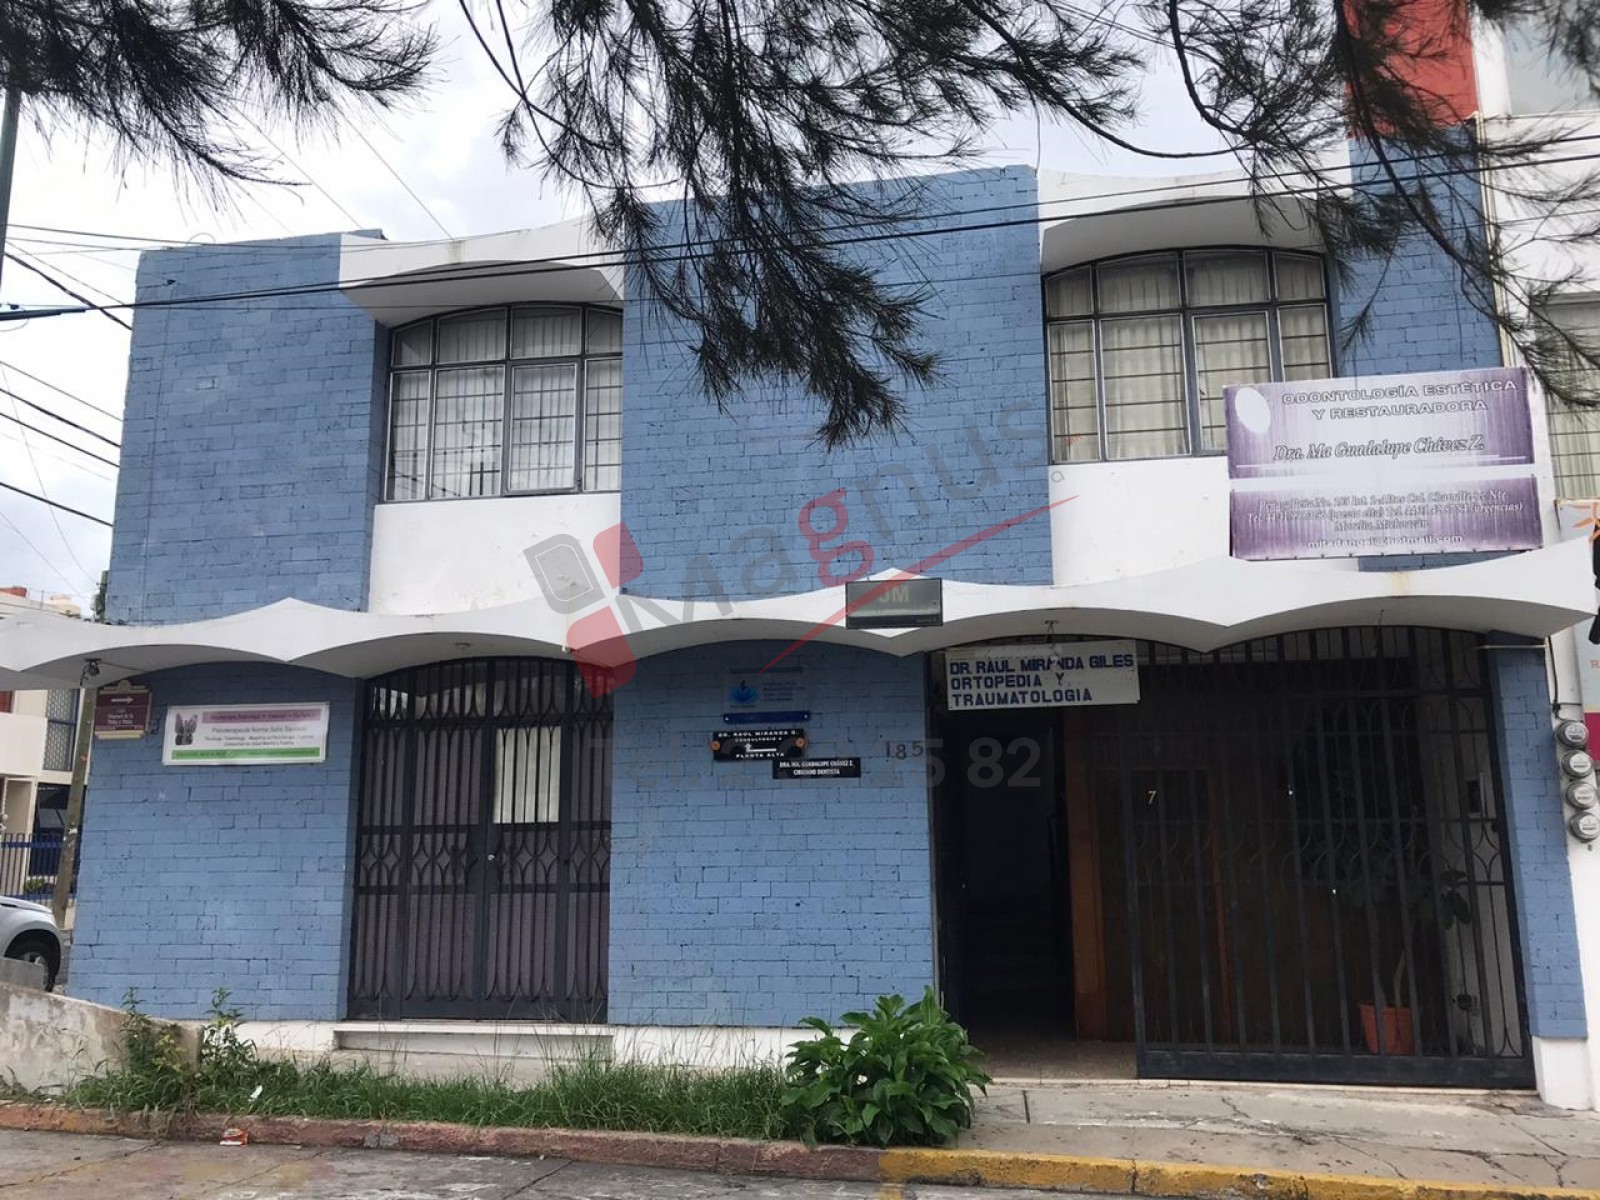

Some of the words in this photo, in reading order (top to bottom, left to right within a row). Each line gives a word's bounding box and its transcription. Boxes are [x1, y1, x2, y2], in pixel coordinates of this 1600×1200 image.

[1281, 384, 1419, 406] ODONTOLOGÍA
[1311, 408, 1326, 421] Y
[1329, 399, 1489, 420] RESTAURADORA
[1273, 445, 1305, 462] Dra.
[1334, 438, 1412, 459] Guadalupe
[949, 662, 972, 676] DR.
[975, 660, 1015, 674] RAUL
[1089, 654, 1133, 669] GILES
[951, 674, 1042, 690] ORTOPEDIA
[1056, 673, 1065, 686] Y
[952, 688, 1092, 706] TRAUMATOLOGIA
[886, 740, 924, 760] 185
[1148, 790, 1157, 805] 7
